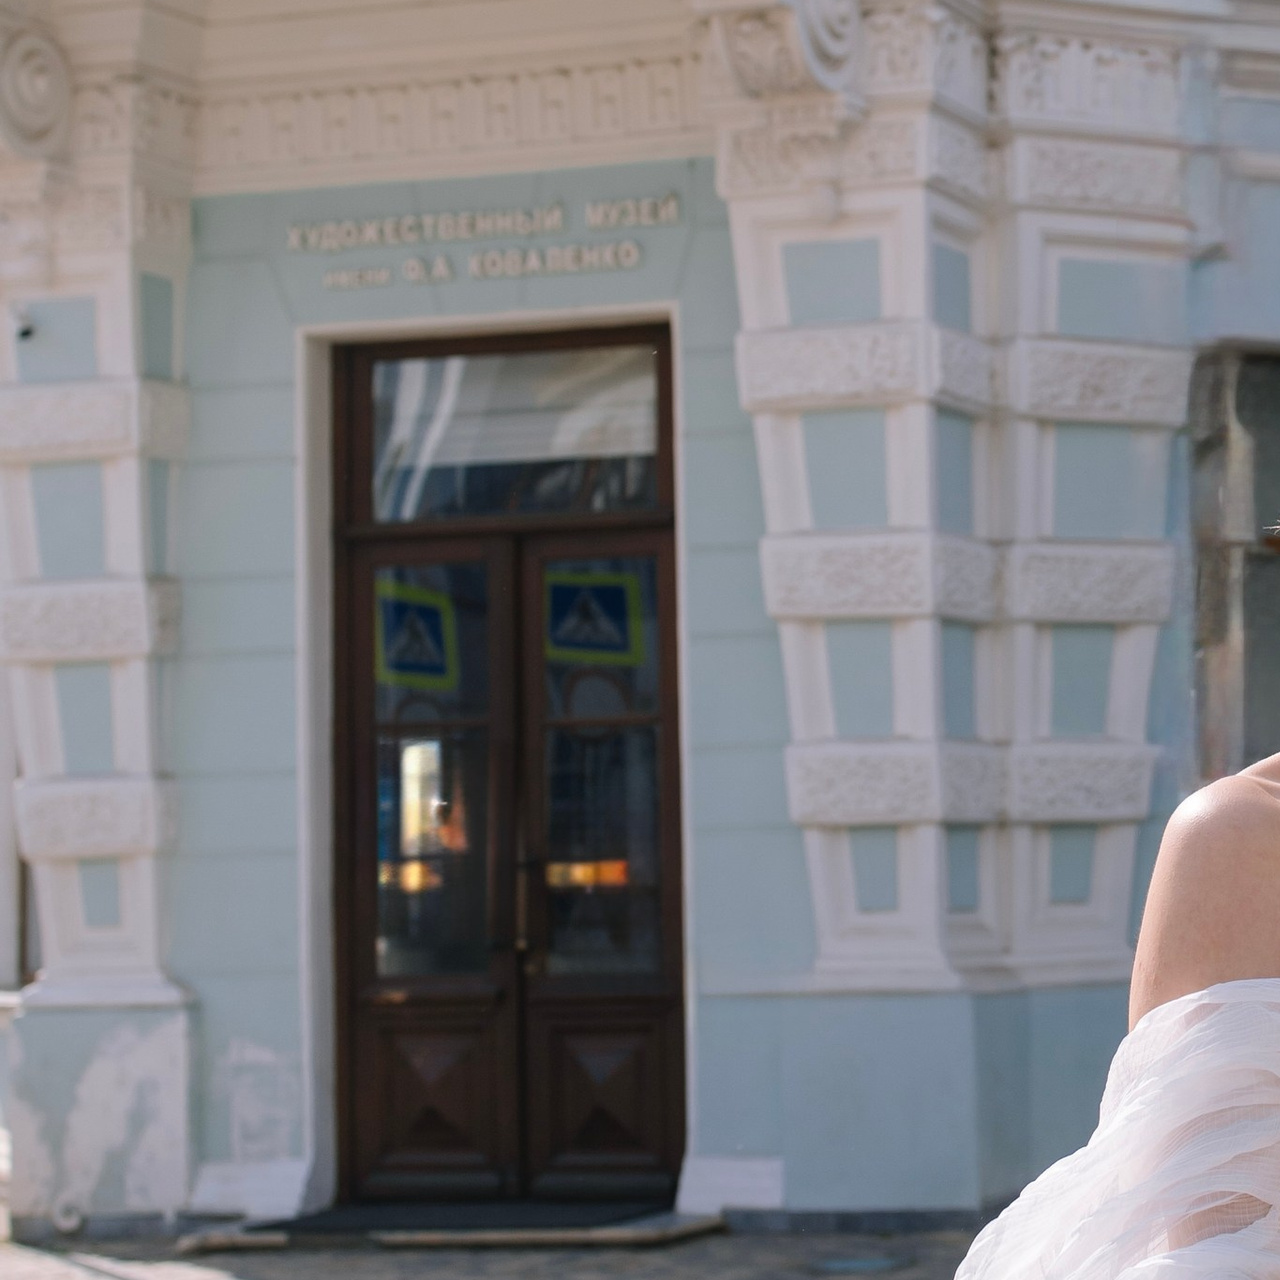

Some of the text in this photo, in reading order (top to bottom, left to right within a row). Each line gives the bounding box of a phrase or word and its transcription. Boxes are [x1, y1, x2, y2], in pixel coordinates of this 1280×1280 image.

[287, 193, 679, 250] ХУДОЖЕСТВЕННЫЙ МУЗЕЙ
[468, 240, 640, 278] КОВАЛЕНКО
